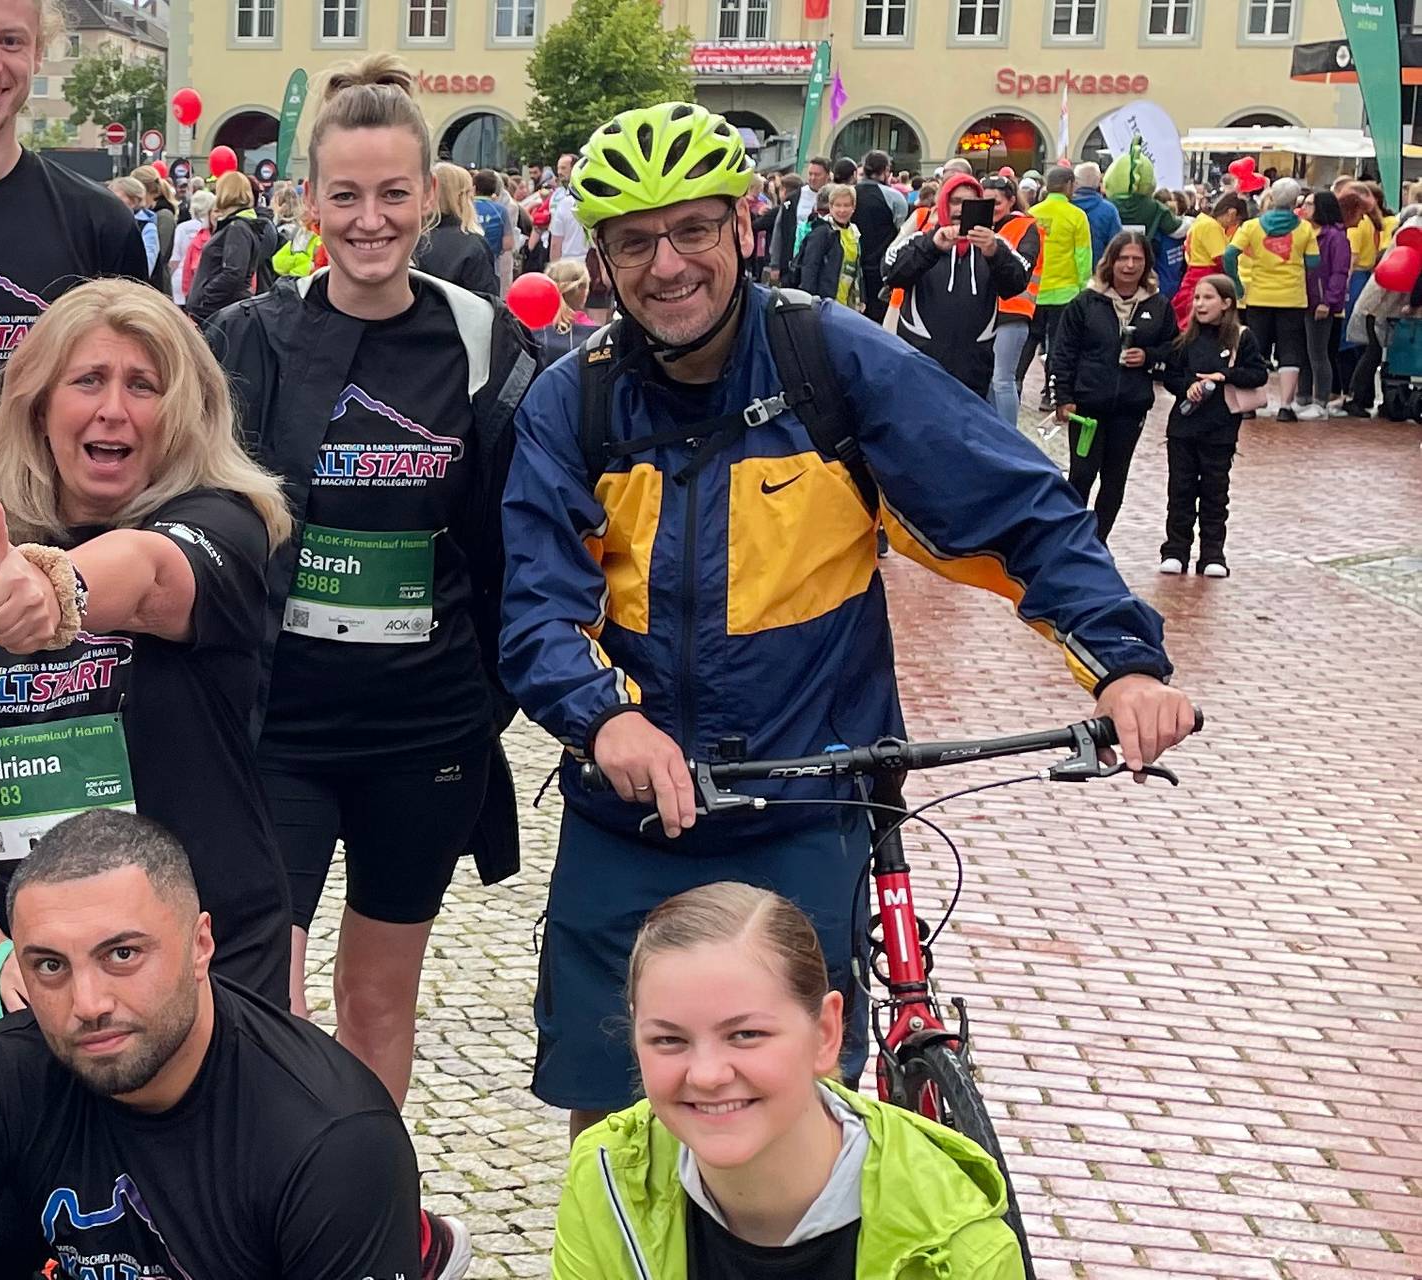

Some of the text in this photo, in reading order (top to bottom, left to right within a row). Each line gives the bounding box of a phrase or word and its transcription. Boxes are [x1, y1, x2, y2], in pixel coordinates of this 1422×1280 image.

[413, 69, 496, 94] kasse
[996, 67, 1149, 98] Sparkasse
[321, 479, 356, 487] MACHEN
[371, 479, 412, 487] KOLLEGEN
[317, 535, 399, 549] AOK-Firmenlauf
[298, 547, 362, 575] Sarah
[296, 572, 340, 594] 5988
[385, 620, 411, 631] AOK
[32, 704, 47, 713] DIE
[75, 724, 114, 737] Hamm
[98, 784, 122, 796] LAUF
[883, 888, 909, 907] M
[143, 1265, 150, 1275] &
